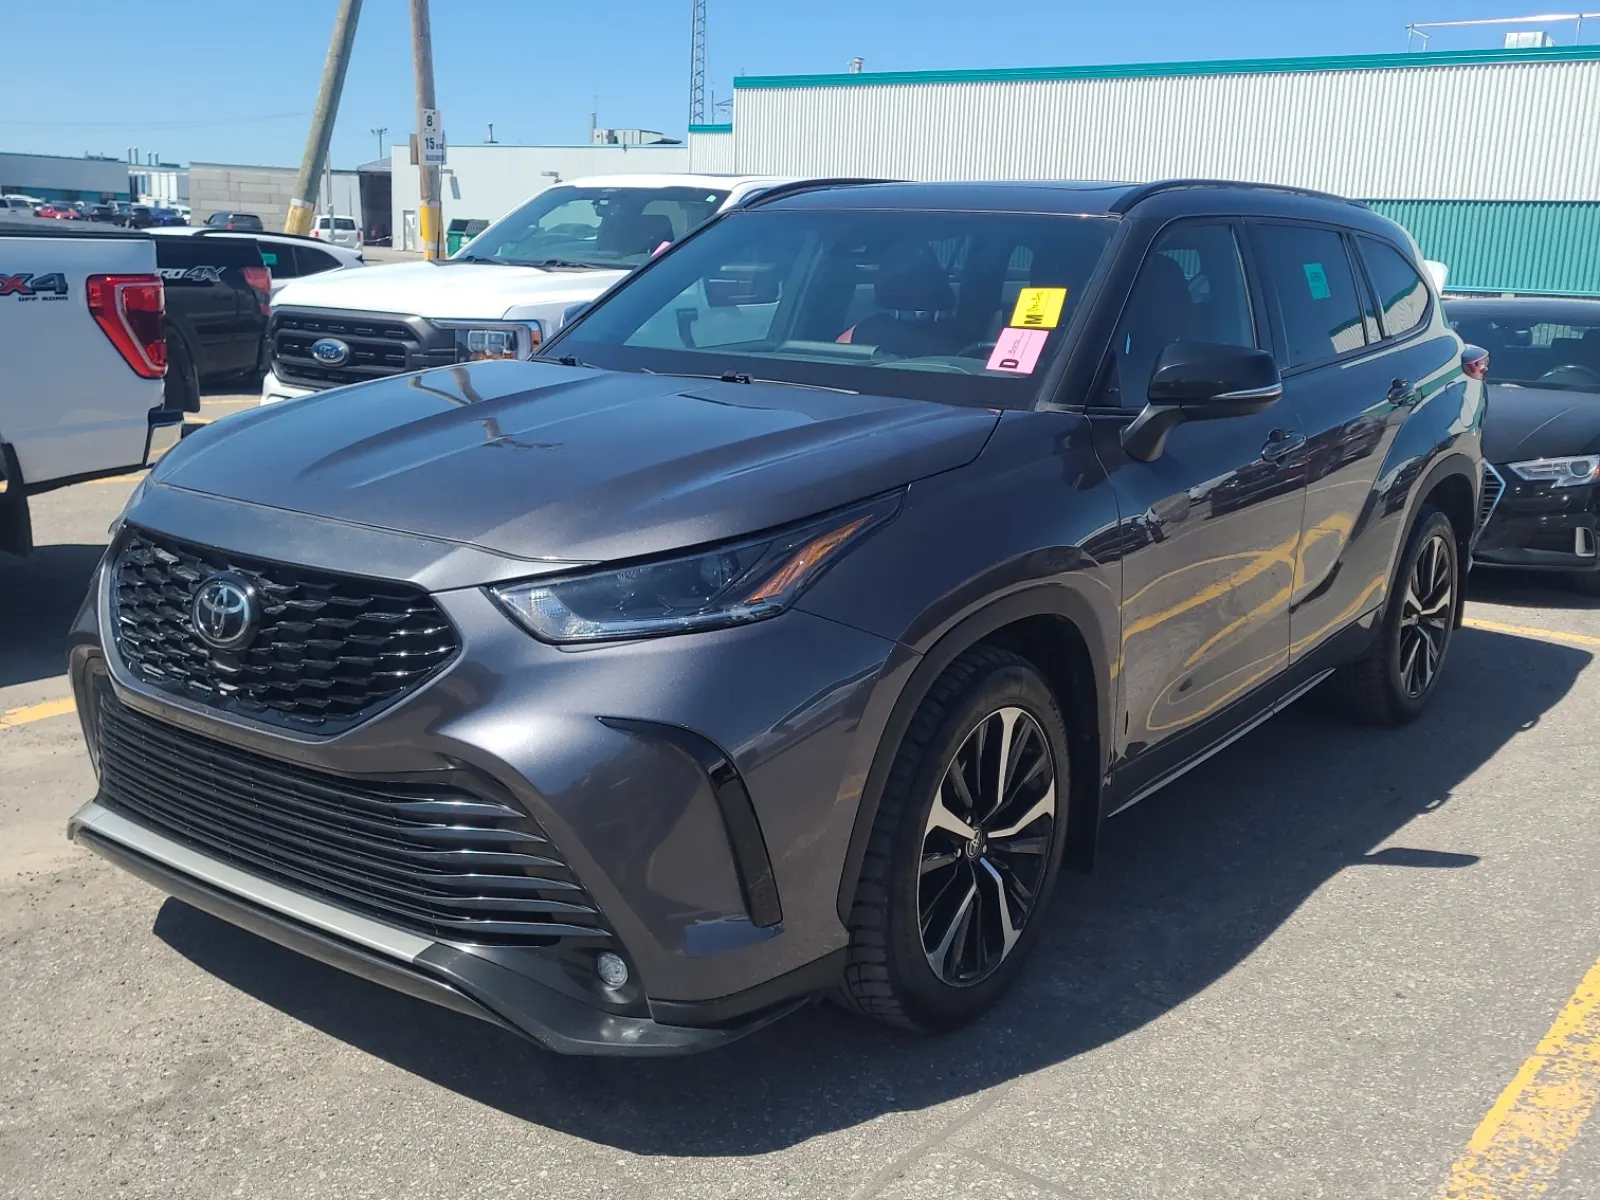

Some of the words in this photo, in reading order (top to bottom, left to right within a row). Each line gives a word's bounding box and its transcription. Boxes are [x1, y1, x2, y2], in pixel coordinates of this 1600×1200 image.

[426, 115, 433, 127] 8
[425, 137, 435, 150] 15
[1023, 314, 1044, 325] M
[998, 358, 1020, 370] D
